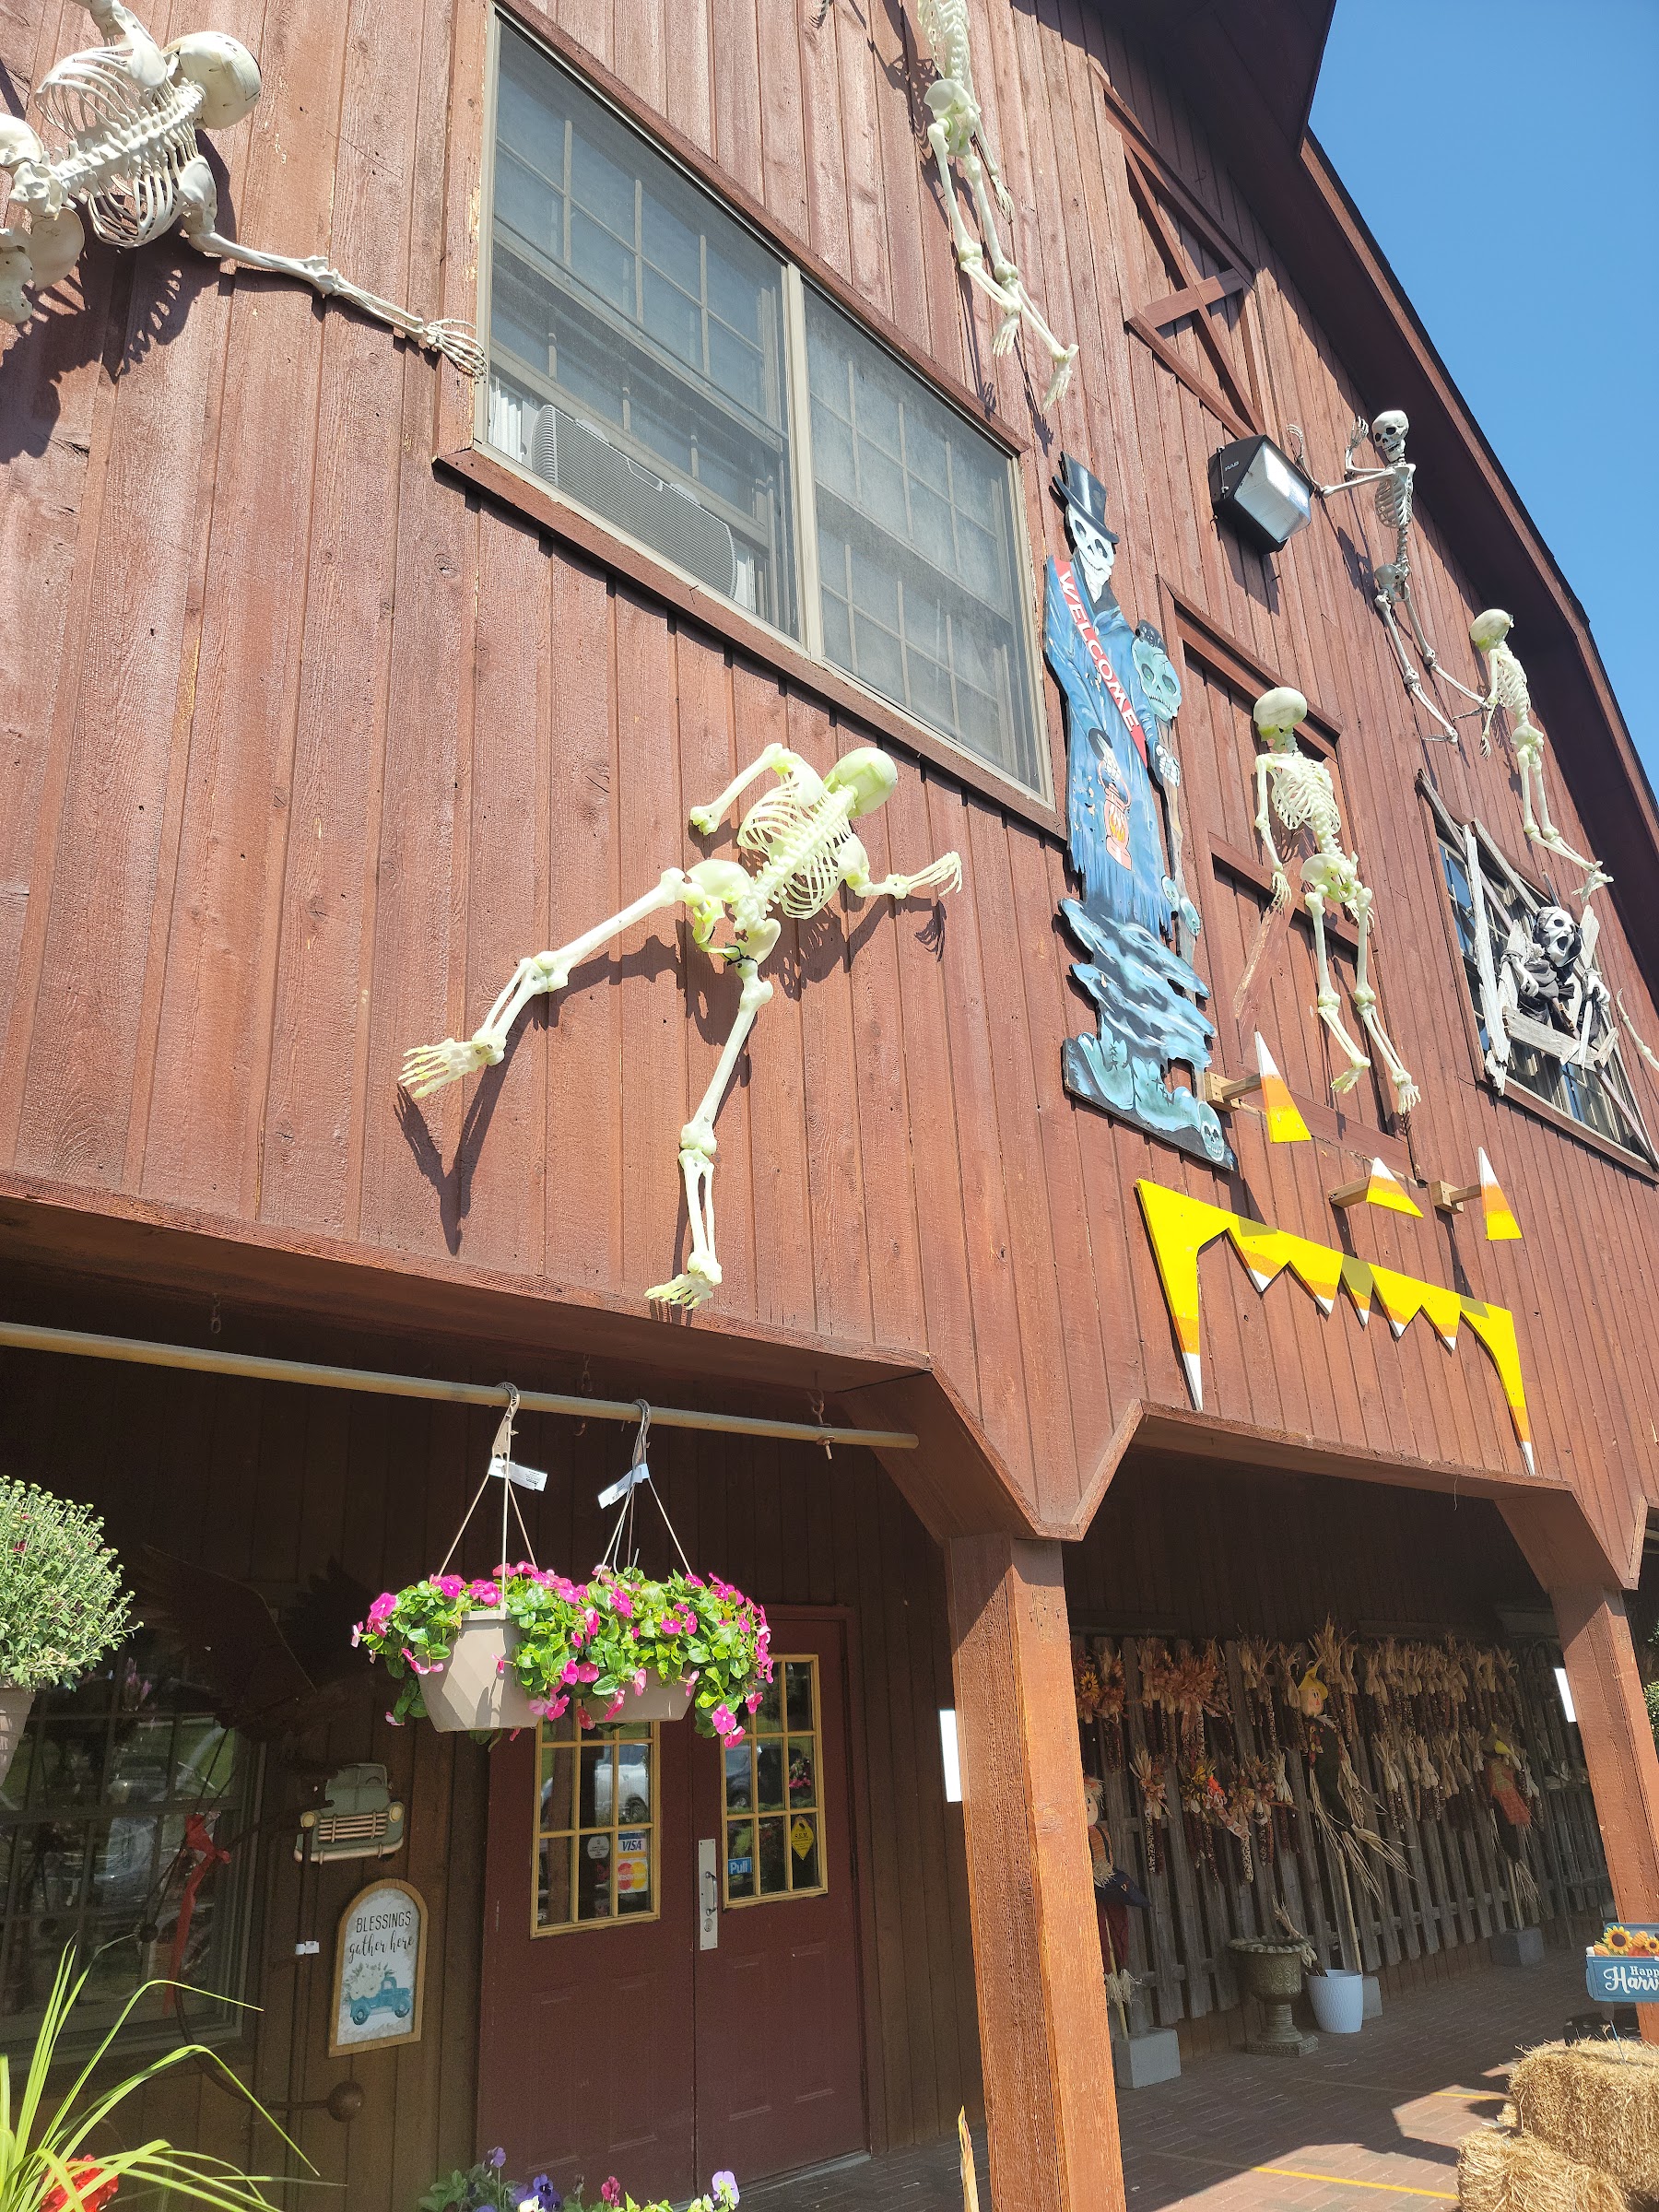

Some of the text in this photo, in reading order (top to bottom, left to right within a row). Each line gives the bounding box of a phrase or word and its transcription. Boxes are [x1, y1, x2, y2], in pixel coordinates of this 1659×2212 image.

[1059, 570, 1139, 732] WELCOME
[622, 1840, 642, 1851] VISA
[730, 1860, 747, 1875] Pull
[356, 1911, 411, 1933] BLESSINGS
[348, 1934, 385, 1964] gather
[390, 1929, 414, 1953] here
